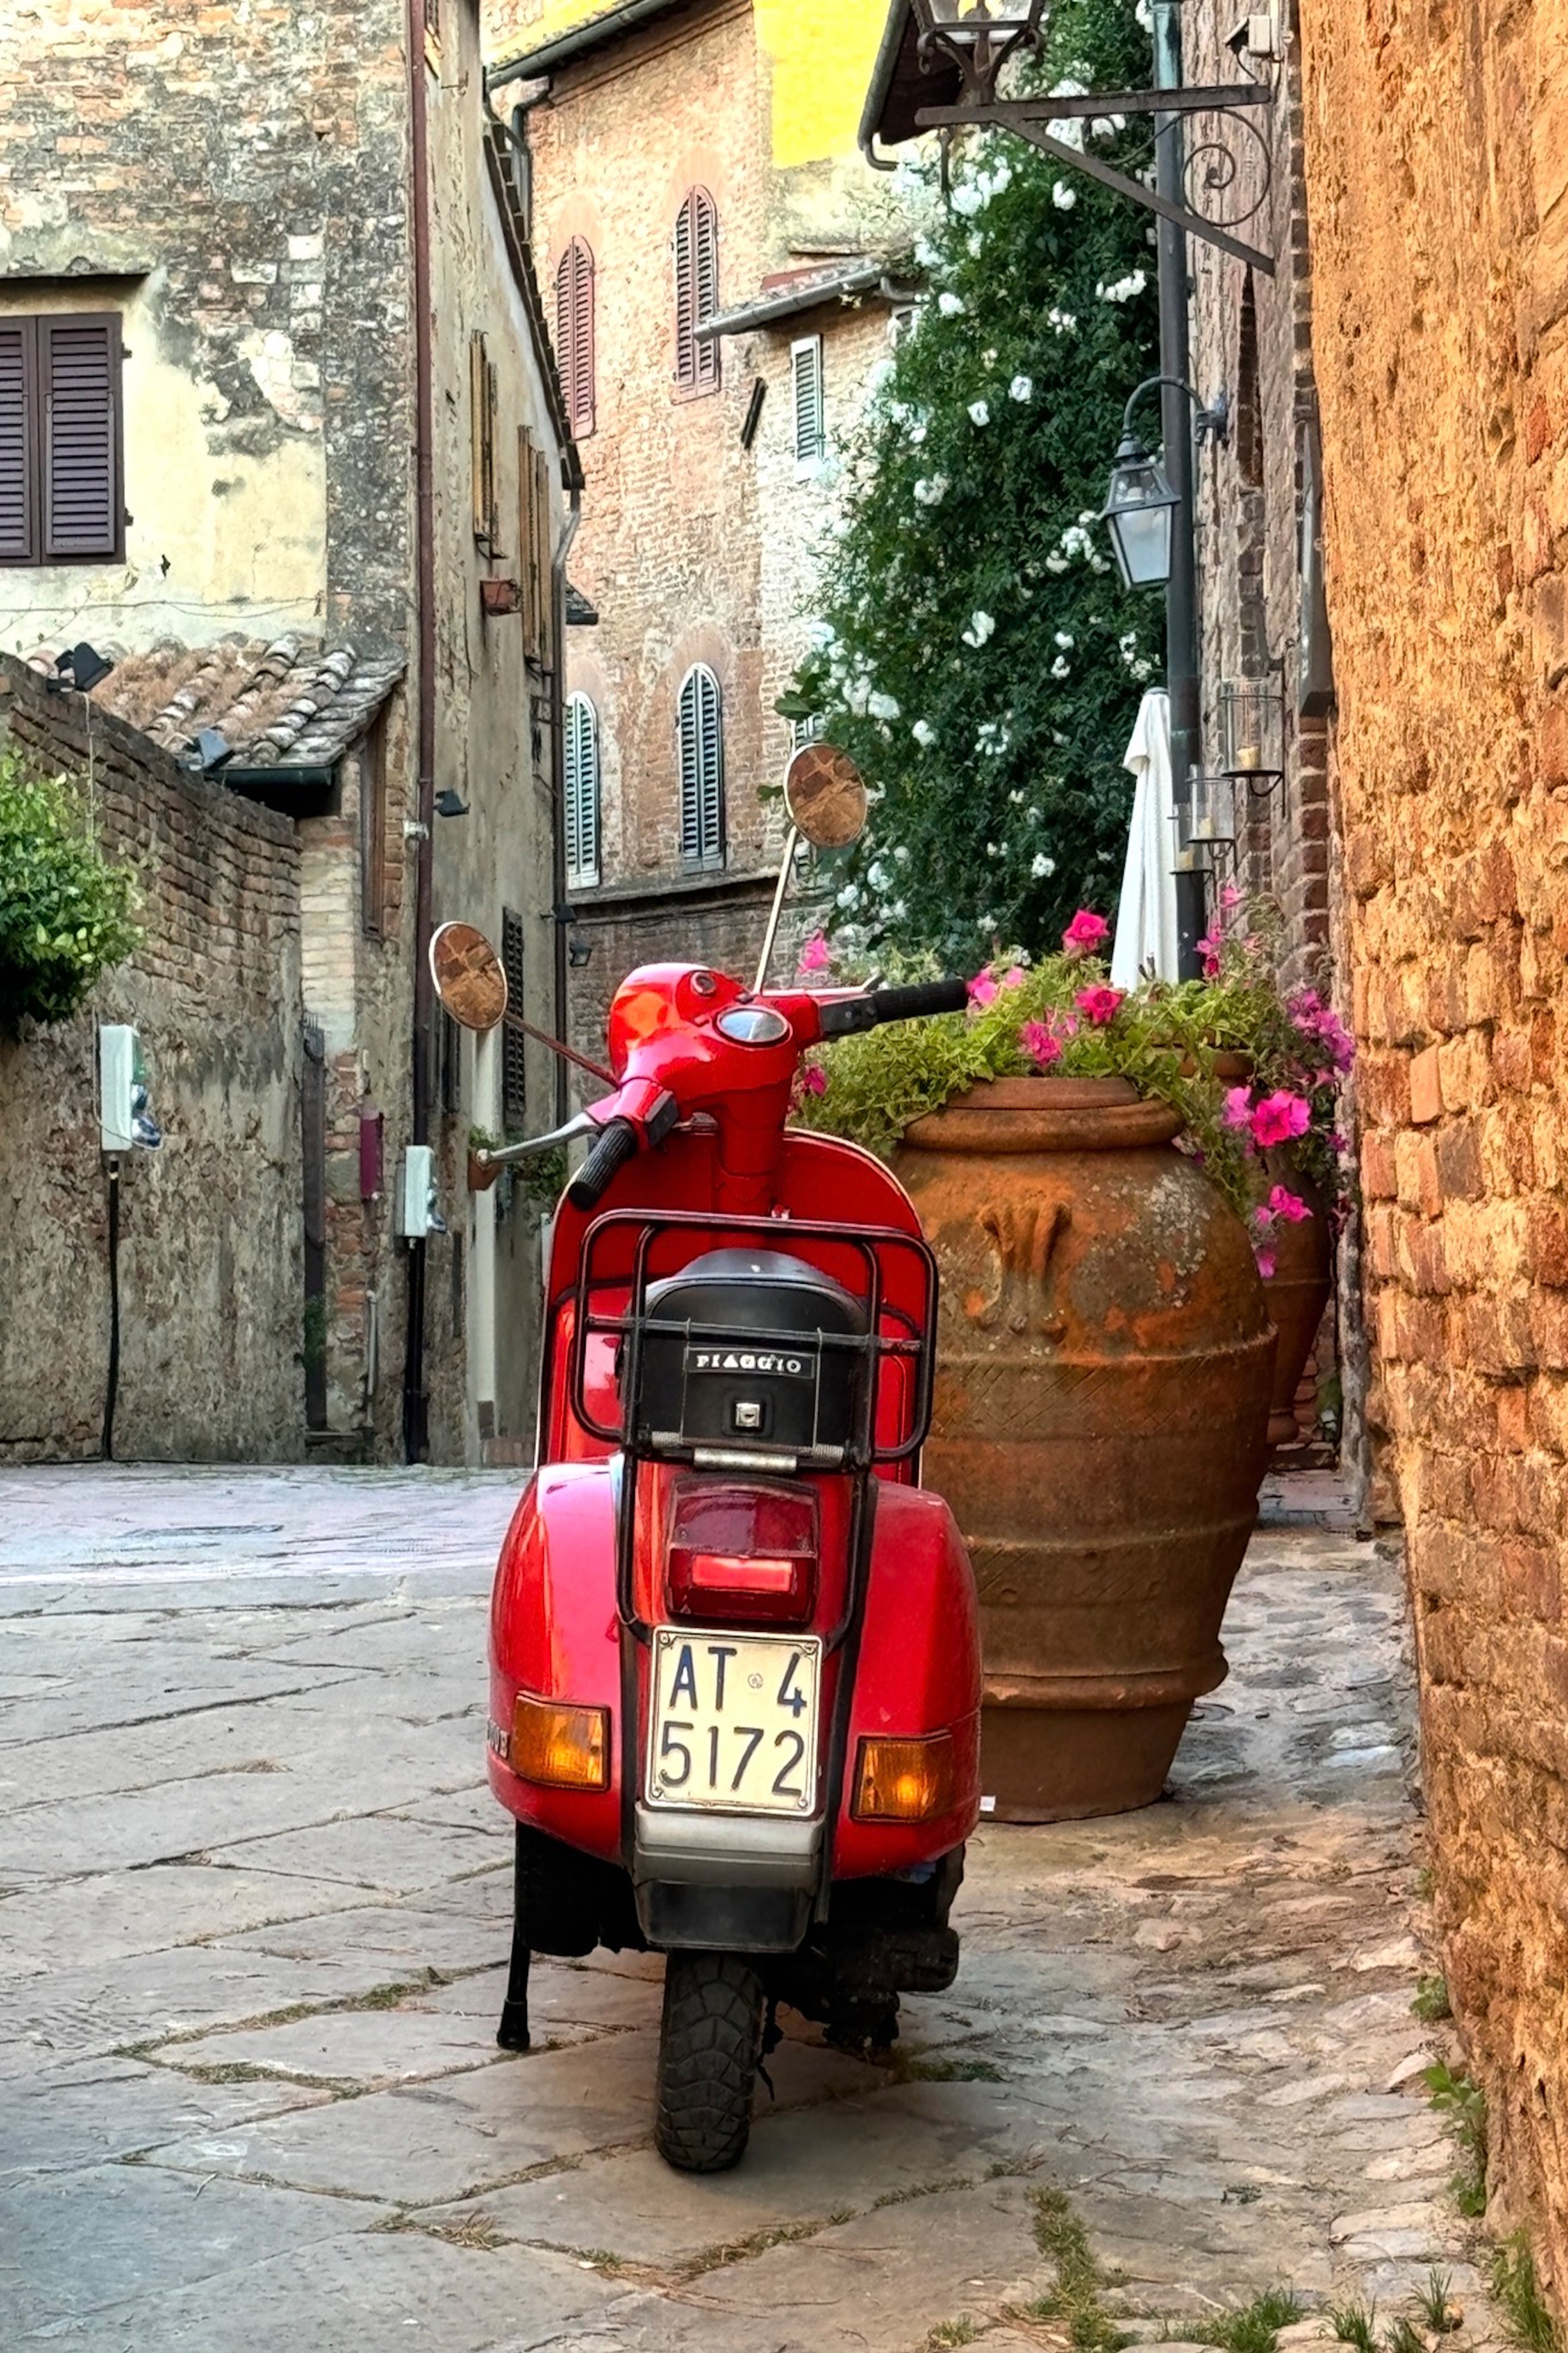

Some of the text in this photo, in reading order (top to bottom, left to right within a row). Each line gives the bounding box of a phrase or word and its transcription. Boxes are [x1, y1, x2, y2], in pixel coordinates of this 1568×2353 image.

[697, 1354, 802, 1373] PIAGGIO
[668, 1644, 807, 1717] AT 4
[659, 1720, 804, 1797] 5172
